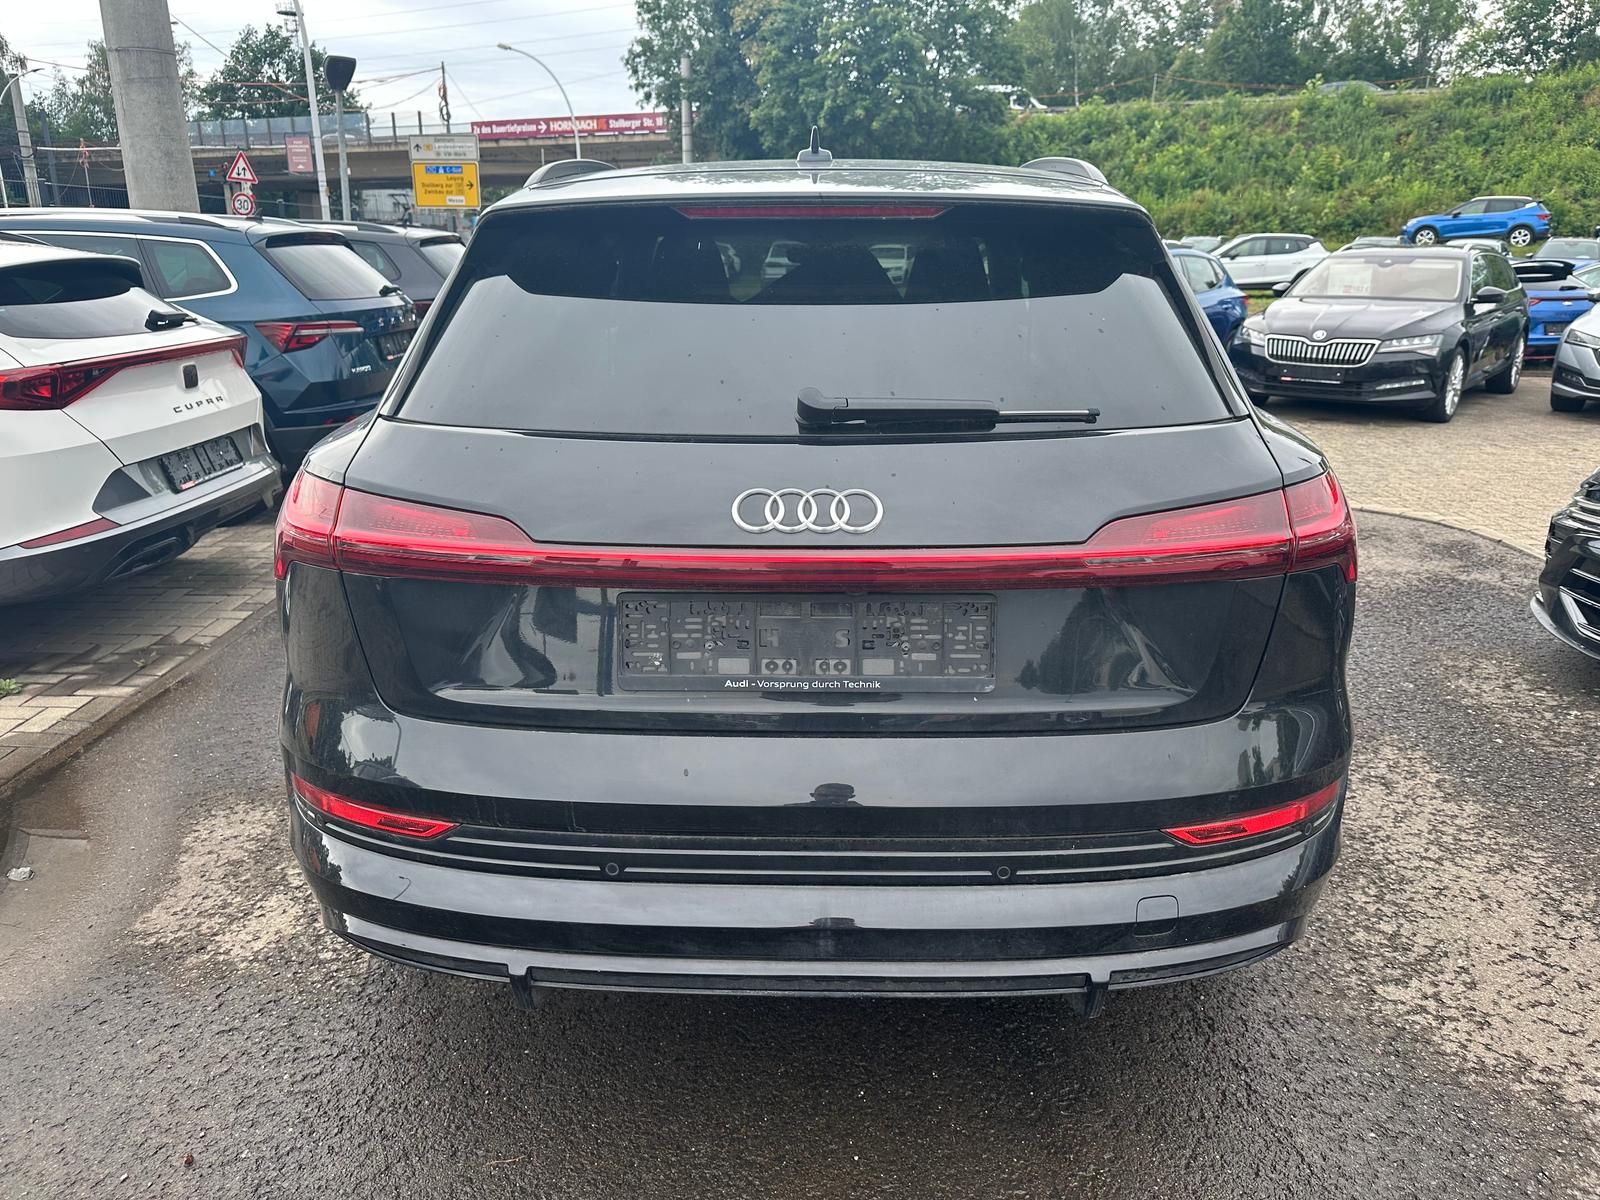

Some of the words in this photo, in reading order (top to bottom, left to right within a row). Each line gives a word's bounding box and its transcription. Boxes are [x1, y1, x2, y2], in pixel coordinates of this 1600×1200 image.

[549, 118, 598, 131] HORNBACH
[236, 199, 249, 210] 30
[173, 395, 224, 413] CUPRA
[724, 679, 749, 688] Audi
[757, 679, 809, 690] Vorsprung
[812, 679, 841, 689] durch
[843, 680, 881, 689] Technik
